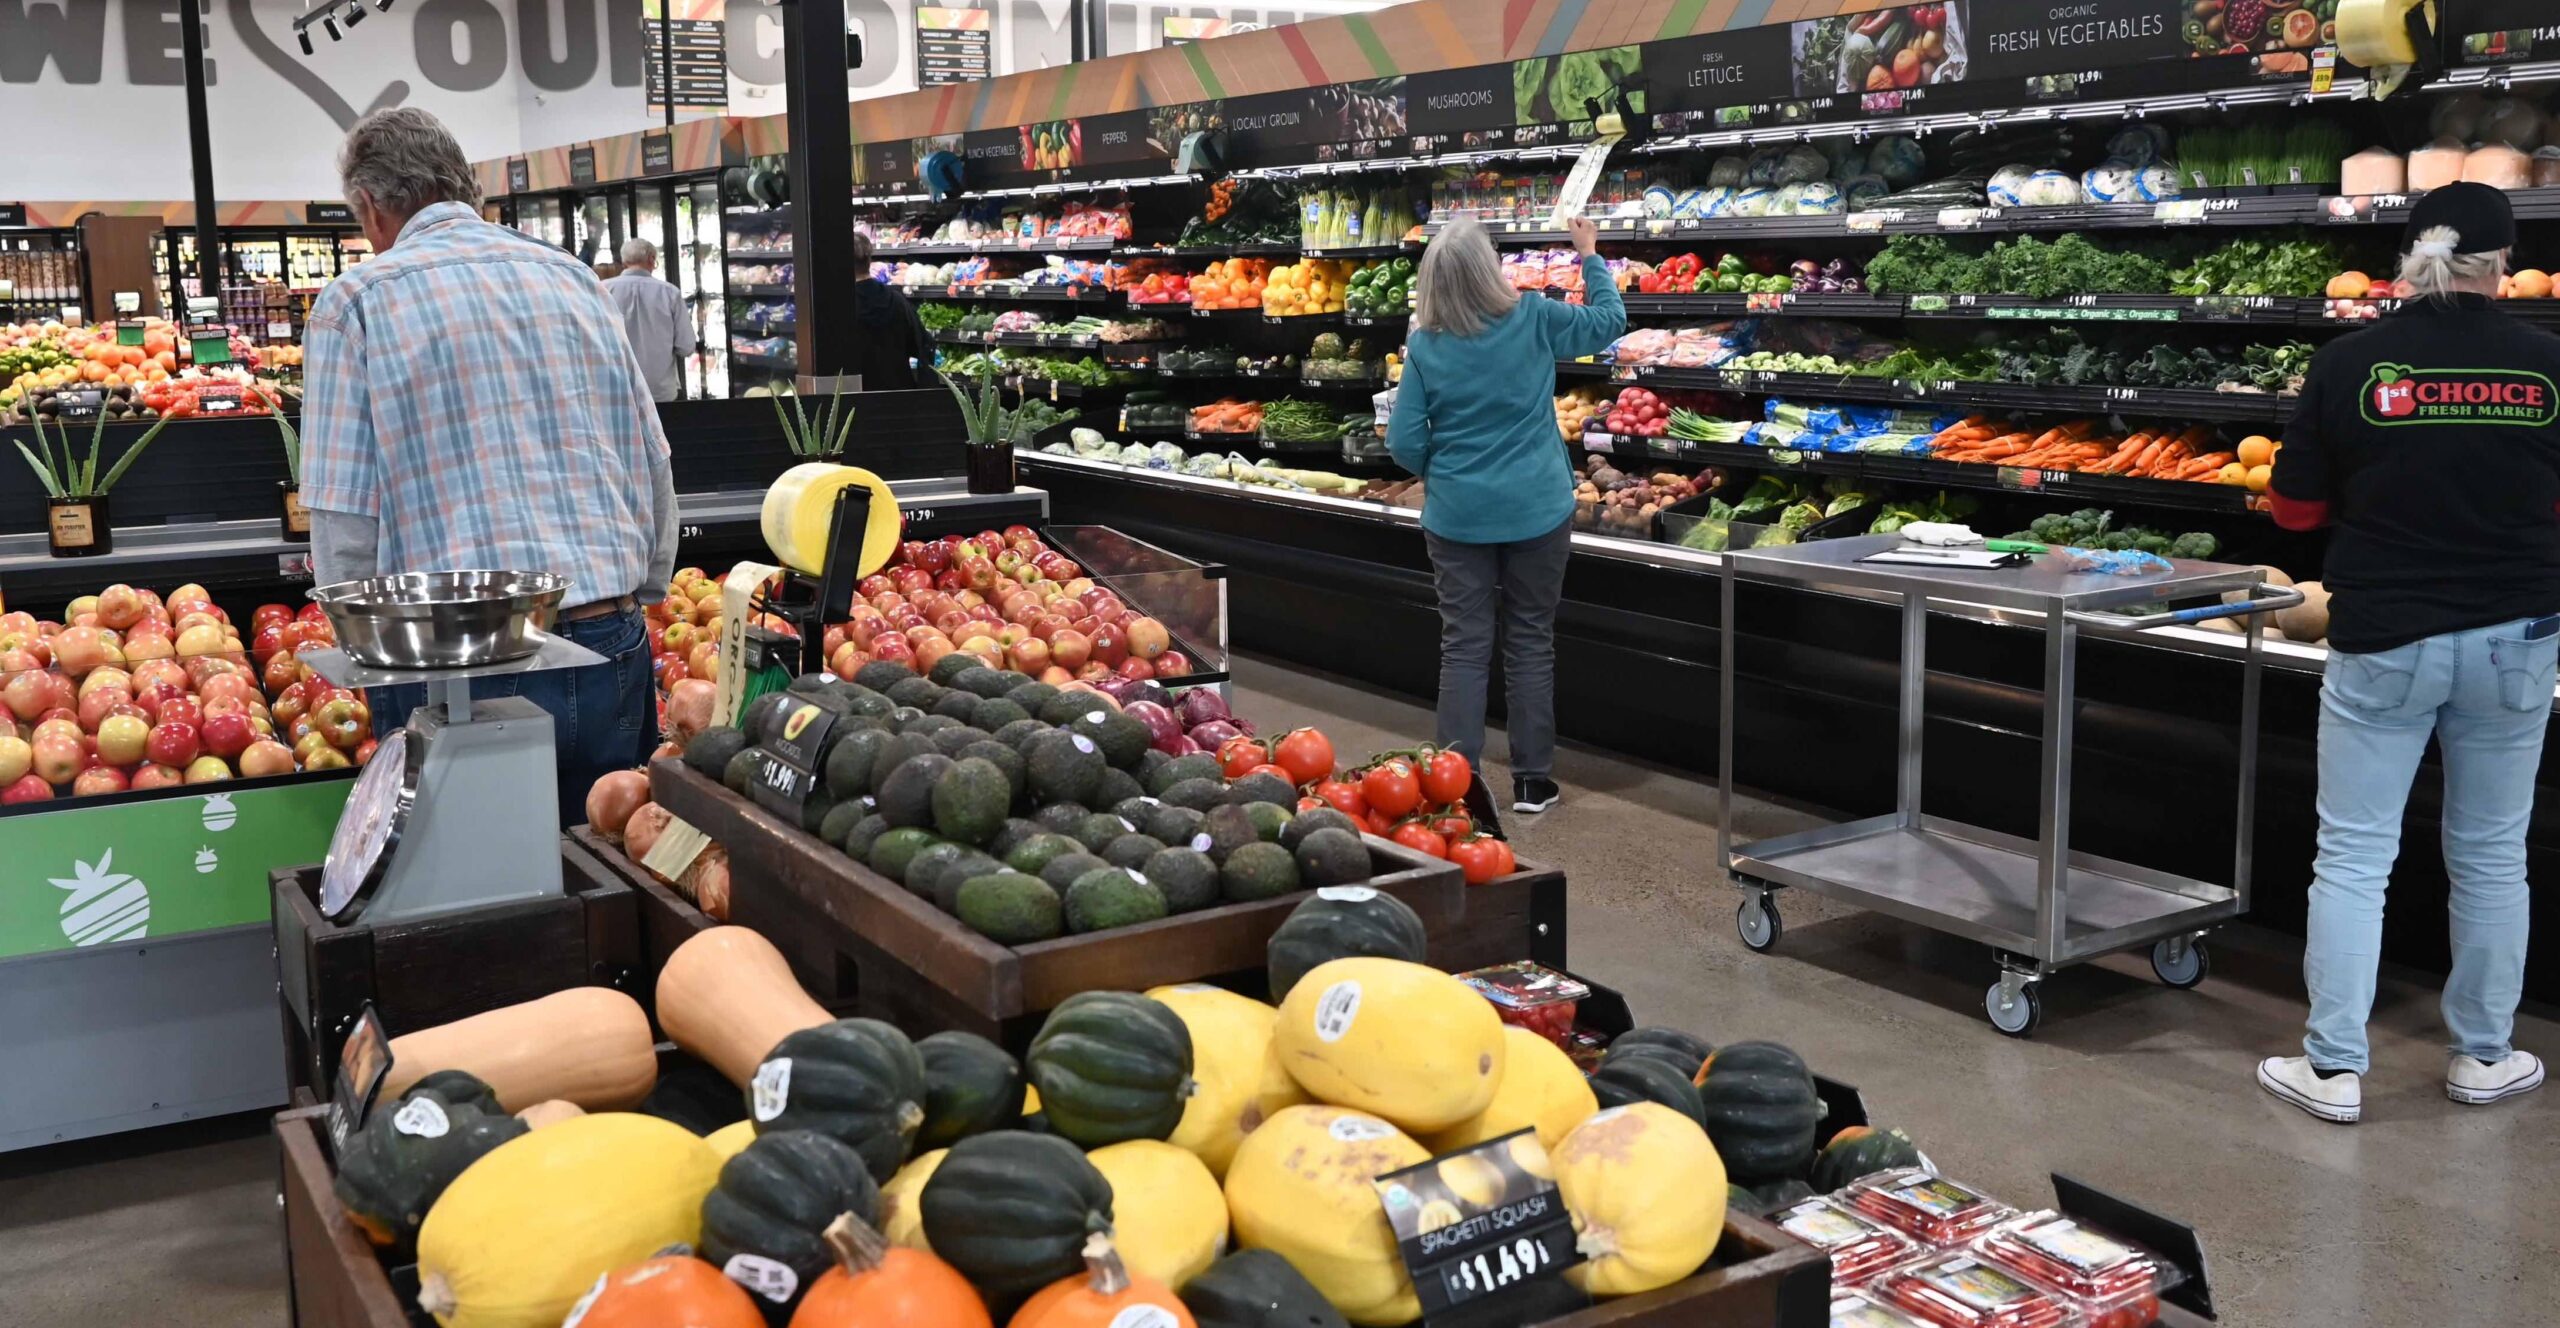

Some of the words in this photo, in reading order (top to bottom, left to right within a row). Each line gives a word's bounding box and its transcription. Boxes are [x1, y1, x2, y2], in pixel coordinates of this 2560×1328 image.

[2049, 3, 2098, 21] ORGANIC
[0, 0, 217, 86] WE
[1989, 28, 2041, 54] FRESH
[2047, 14, 2164, 46] VEGETABLES
[1702, 52, 1723, 64] FRESH
[1688, 65, 1744, 88] LETTUCE
[1427, 89, 1493, 110] MUSHROOMS
[1232, 113, 1267, 131] LOCALLY
[1269, 110, 1300, 128] GROWN
[1102, 131, 1128, 145] PEPPERS
[1988, 308, 2015, 318] Organic
[2034, 308, 2062, 318] Organic
[2081, 309, 2110, 319] Organic
[2129, 309, 2159, 319] Organic
[2377, 385, 2409, 412] 1st
[2416, 382, 2544, 406] CHOICE
[2419, 405, 2472, 416] FRESH
[2478, 405, 2545, 419] MARKET
[1419, 1214, 1491, 1255] SPAGHETTI
[1491, 1196, 1548, 1230] SQUASH
[1459, 1238, 1537, 1292] $1.49
